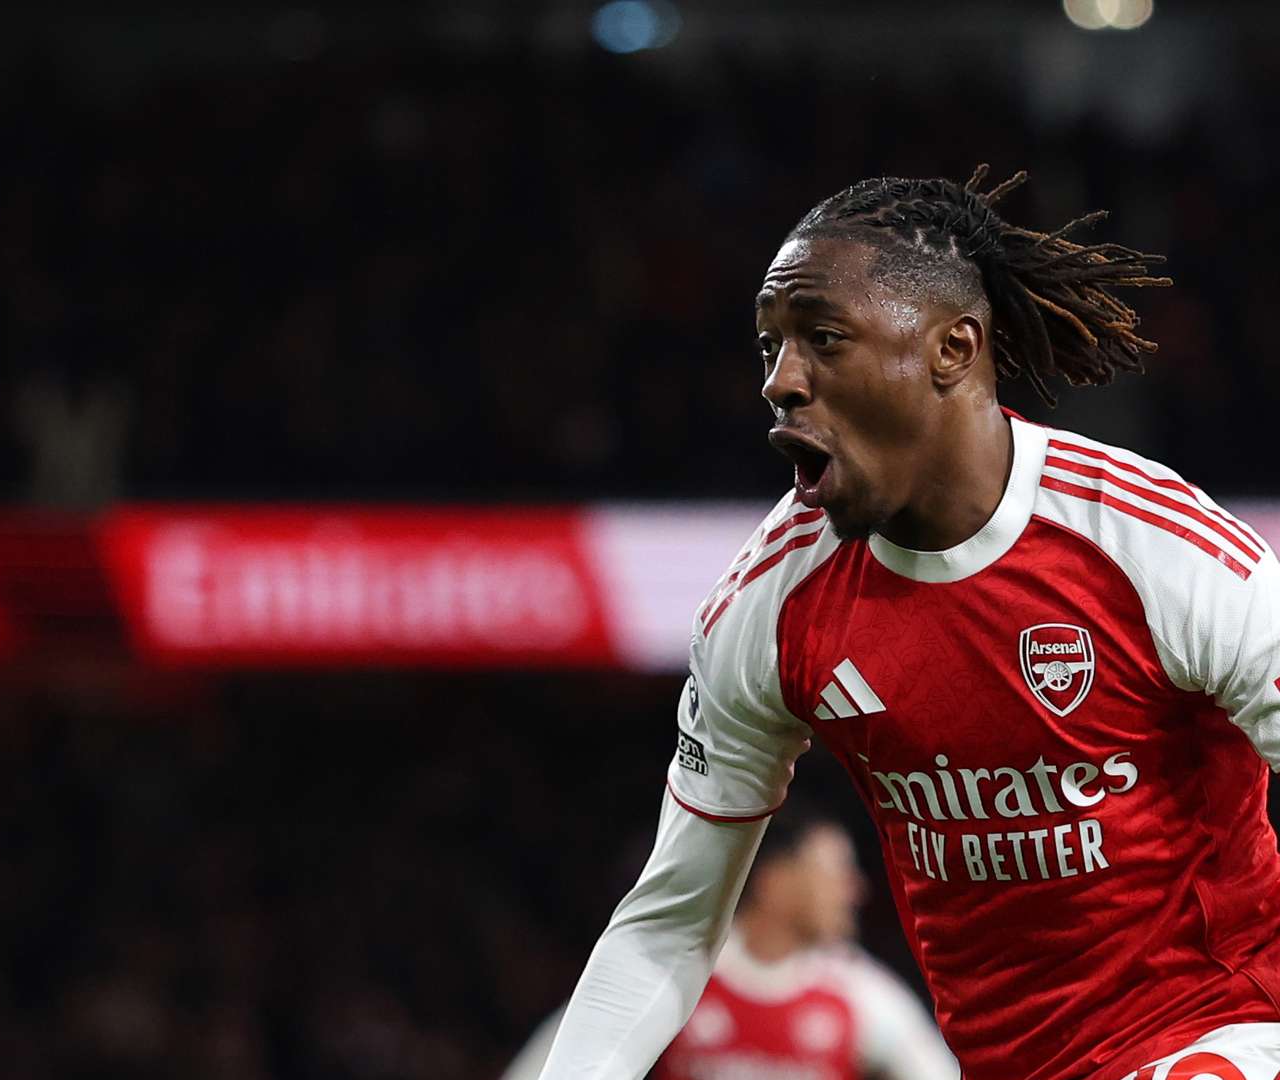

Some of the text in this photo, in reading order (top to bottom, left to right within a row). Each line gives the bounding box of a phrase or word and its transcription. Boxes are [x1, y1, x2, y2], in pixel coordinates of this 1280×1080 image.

[1029, 640, 1082, 655] Arsenal
[870, 752, 1139, 820] mirates
[908, 819, 1110, 882] FLY BETTER
